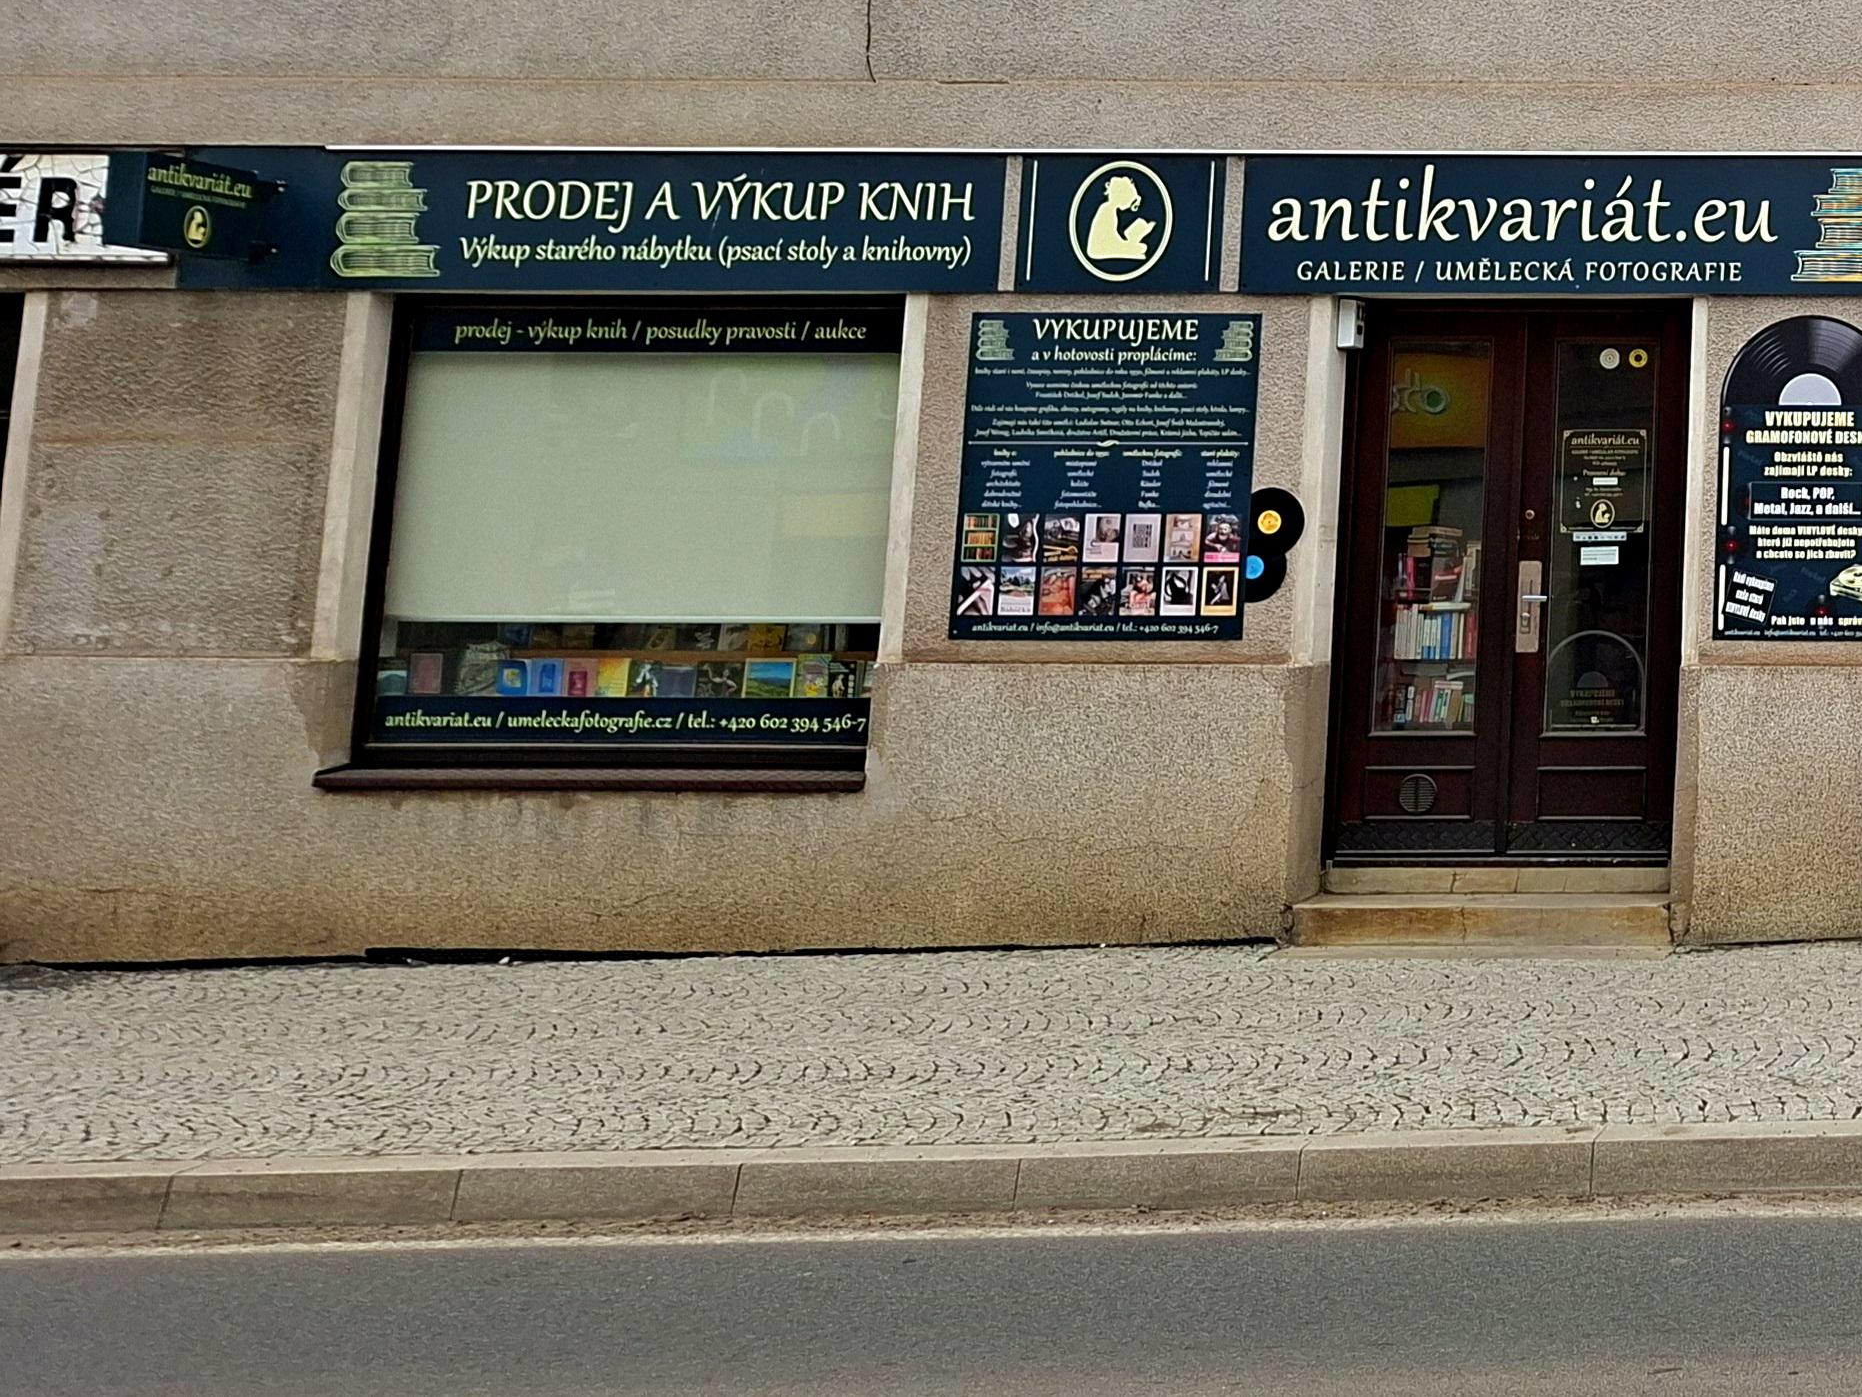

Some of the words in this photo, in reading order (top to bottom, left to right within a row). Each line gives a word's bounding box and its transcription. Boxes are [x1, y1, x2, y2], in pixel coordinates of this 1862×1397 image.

[466, 179, 633, 233] PRODEJ
[645, 181, 681, 221] A
[692, 173, 845, 221] VÝKUP
[859, 181, 975, 221] KNIH
[1267, 164, 1778, 244] antikvariát.eu
[459, 234, 531, 269] Výkup
[535, 234, 616, 262] starého
[622, 234, 713, 269] nábytku
[718, 235, 784, 269] (psací
[787, 235, 838, 269] stoly
[842, 245, 857, 262] a
[862, 235, 972, 269] knihovny)
[1296, 259, 1405, 282] GALERIE
[1435, 256, 1574, 282] UMĚLECKÁ
[1585, 260, 1743, 282] FOTOGRAFIE
[455, 317, 512, 346] prodej
[528, 318, 583, 346] výkup
[586, 318, 627, 339] knih
[646, 318, 722, 346] posudky
[725, 321, 797, 346] pravosti
[815, 319, 867, 339] aukce
[1033, 319, 1199, 347] VYKUPUJEME
[1031, 351, 1040, 361] a
[1042, 350, 1051, 361] v
[1054, 346, 1114, 362] hotovosti
[1118, 346, 1197, 365] proplácíme:
[1765, 411, 1855, 427] VYKUPUJEME
[1571, 433, 1639, 445] antikvariát.eu
[1746, 429, 1833, 444] GRAMOFONOVÉ
[1824, 451, 1844, 463] nás
[1806, 465, 1818, 476] LP
[1780, 487, 1810, 500] Rock,
[1812, 487, 1835, 500] POP,
[1754, 503, 1788, 516] Metal,
[1789, 503, 1814, 516] Jazz,
[385, 709, 492, 728] antikvariat.eu
[508, 710, 672, 733] umeleckafotografie.cz
[688, 710, 715, 728] tel.:
[719, 715, 756, 732] +420
[760, 714, 788, 729] 602
[790, 715, 819, 732] 394
[822, 714, 867, 733] 546-7
